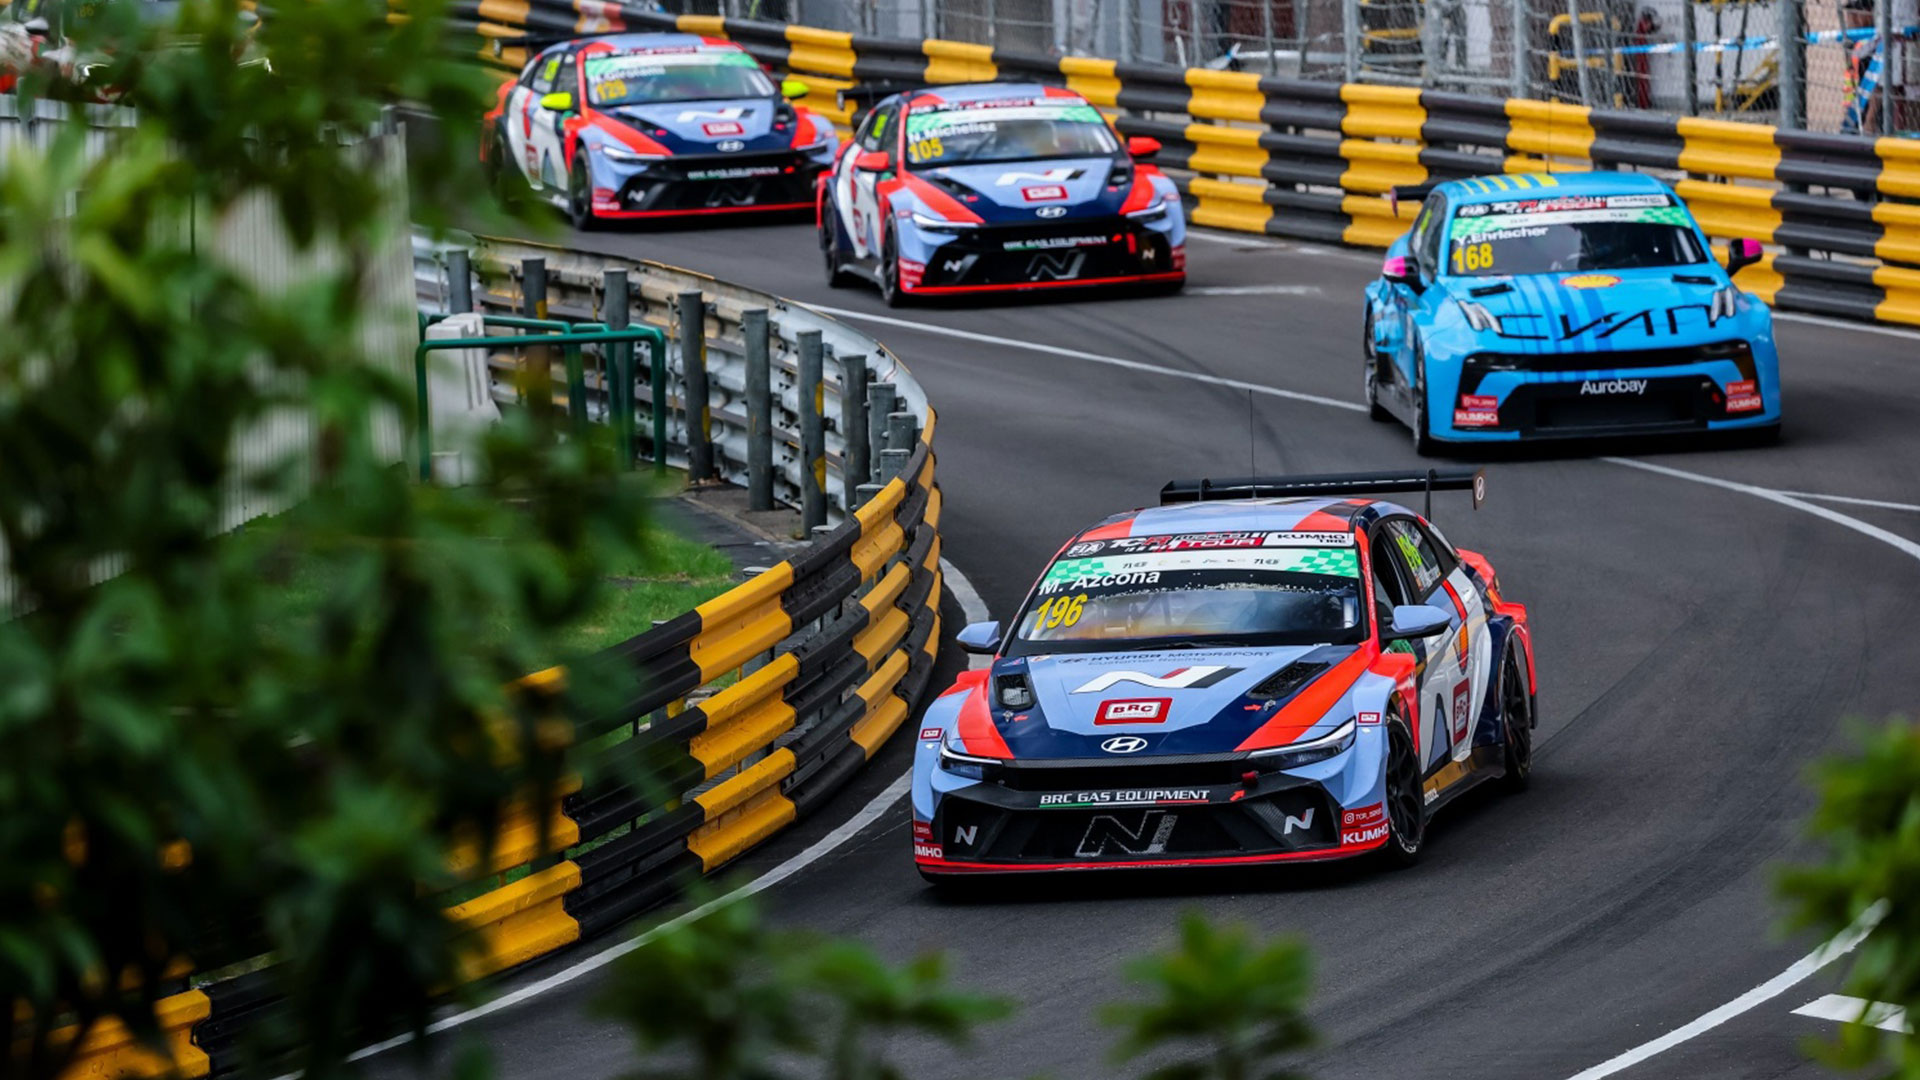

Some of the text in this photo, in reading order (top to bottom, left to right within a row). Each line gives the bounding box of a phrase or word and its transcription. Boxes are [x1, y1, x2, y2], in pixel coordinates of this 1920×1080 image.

[909, 137, 945, 163] 105
[1452, 243, 1494, 273] 168
[1580, 380, 1647, 395] Aurobay
[1068, 542, 1101, 555] FIA
[1037, 572, 1161, 596] M. Azcona
[1035, 594, 1088, 630] 196
[1112, 703, 1154, 715] BRC
[1040, 790, 1210, 804] BRC GAS EQUIPMENT
